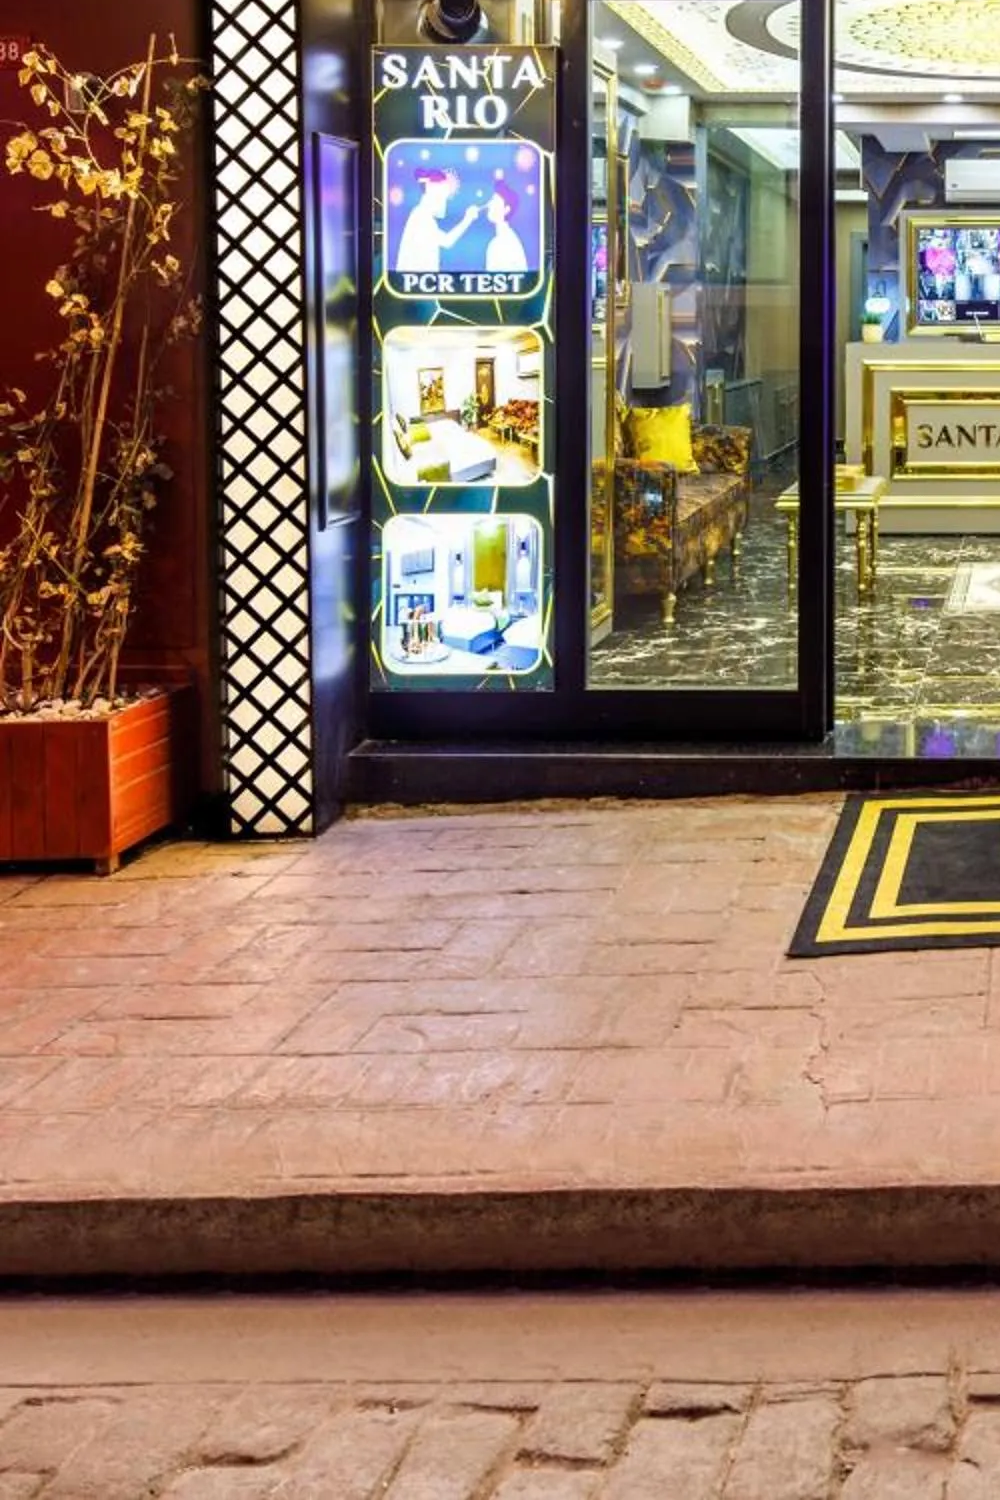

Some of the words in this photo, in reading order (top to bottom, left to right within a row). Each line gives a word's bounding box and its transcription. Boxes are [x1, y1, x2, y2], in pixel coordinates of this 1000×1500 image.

[381, 54, 546, 90] SANTA
[422, 95, 509, 130] RIO
[402, 272, 456, 294] PCR
[459, 272, 525, 294] TEST
